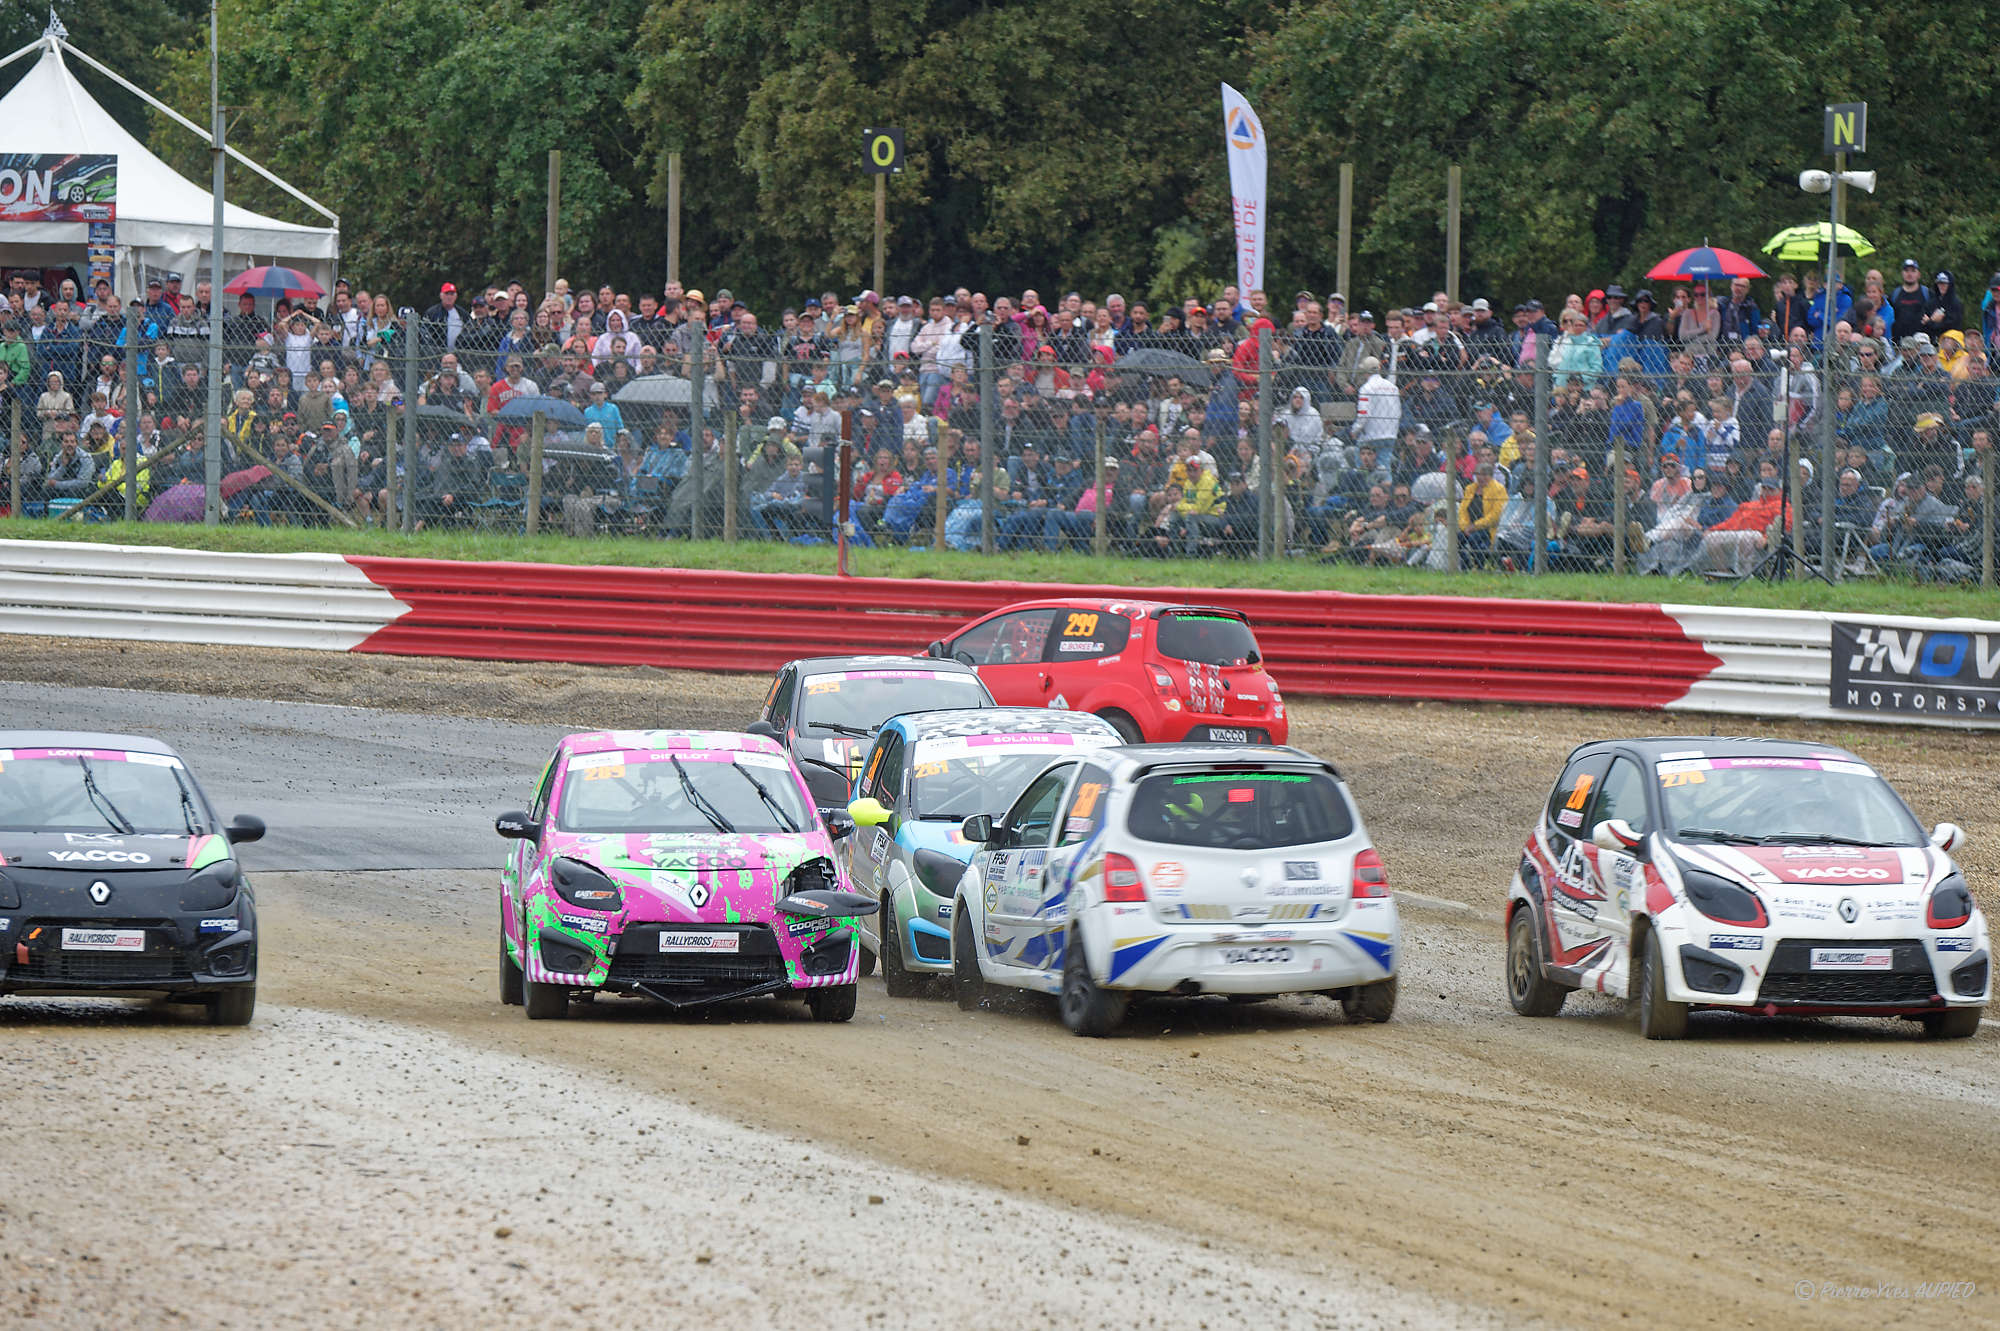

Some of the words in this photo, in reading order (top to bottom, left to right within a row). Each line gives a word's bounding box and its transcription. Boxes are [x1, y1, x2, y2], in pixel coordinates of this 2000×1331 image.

[1834, 111, 1855, 145] N
[870, 135, 896, 167] O
[1063, 612, 1099, 637] 299
[1847, 690, 2000, 713] MOTORSP
[1212, 729, 1246, 741] YACCO
[48, 849, 151, 864] YACCO
[651, 856, 747, 868] YACCO
[1787, 866, 1890, 879] YACCO
[562, 914, 608, 928] COOPER
[789, 916, 830, 932] COOPER
[67, 932, 118, 944] RALLYCROSS
[664, 935, 713, 946] RALLYCROSS
